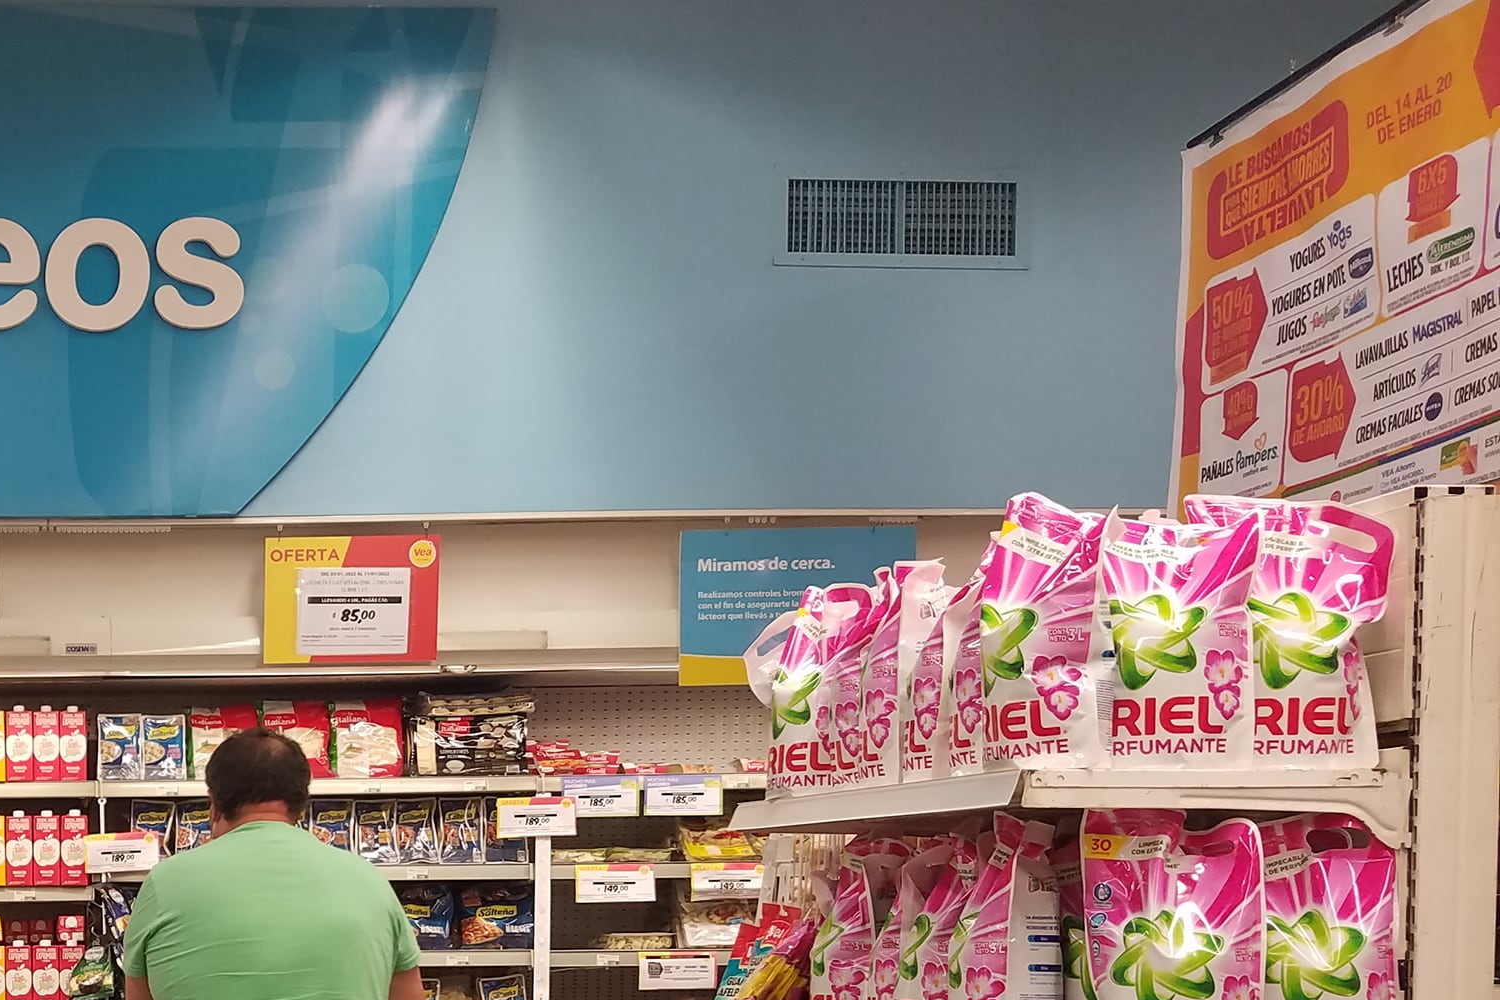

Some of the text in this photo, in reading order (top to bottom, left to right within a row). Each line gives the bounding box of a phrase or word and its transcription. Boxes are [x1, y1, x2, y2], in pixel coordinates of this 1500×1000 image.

[1367, 72, 1453, 129] DEL 14 AL 20
[1378, 99, 1441, 144] DE ENERO
[1228, 161, 1243, 188] LE
[1289, 237, 1326, 273] YOGURES
[1386, 252, 1425, 293] LECHES
[1272, 282, 1312, 317] YOGURES
[1313, 275, 1326, 299] EN
[1326, 264, 1347, 292] POTE
[1471, 290, 1497, 319] PAPEL
[1212, 284, 1253, 330] 50%
[1276, 315, 1308, 347] JUGOS
[1355, 310, 1463, 370] LAVAVAJILLAS MAGISTRAL
[1465, 332, 1498, 363] CREMAS
[1373, 368, 1417, 402] ARTÍCULOS
[1454, 376, 1487, 406] CREMAS
[1296, 372, 1344, 427] 30%
[1292, 412, 1345, 447] DE AHORRO
[1355, 402, 1423, 445] CREMAS FACIALES
[1201, 446, 1279, 484] PAÑALES Pampers
[269, 548, 340, 562] OFERTA
[414, 548, 432, 557] Vea
[697, 556, 836, 572] Miramos de cerca.
[697, 589, 781, 599] Realizamos controles
[735, 601, 745, 609] de
[746, 601, 790, 610] asegurarte
[340, 608, 376, 625] 85,00
[697, 611, 767, 622] lácteos que llevás
[1068, 628, 1085, 641] 3 L
[264, 717, 297, 727] Italiana
[1112, 696, 1224, 738] RIEL
[1254, 696, 1352, 738] RIEL
[1112, 738, 1228, 757] RFUMANTE
[589, 797, 614, 807] 185,00
[672, 795, 697, 805] 185,00
[524, 817, 550, 827] 189,00
[111, 853, 135, 863] 189,00
[1091, 838, 1112, 851] 30
[603, 884, 629, 894] 149,00
[477, 905, 516, 919] Salteña
